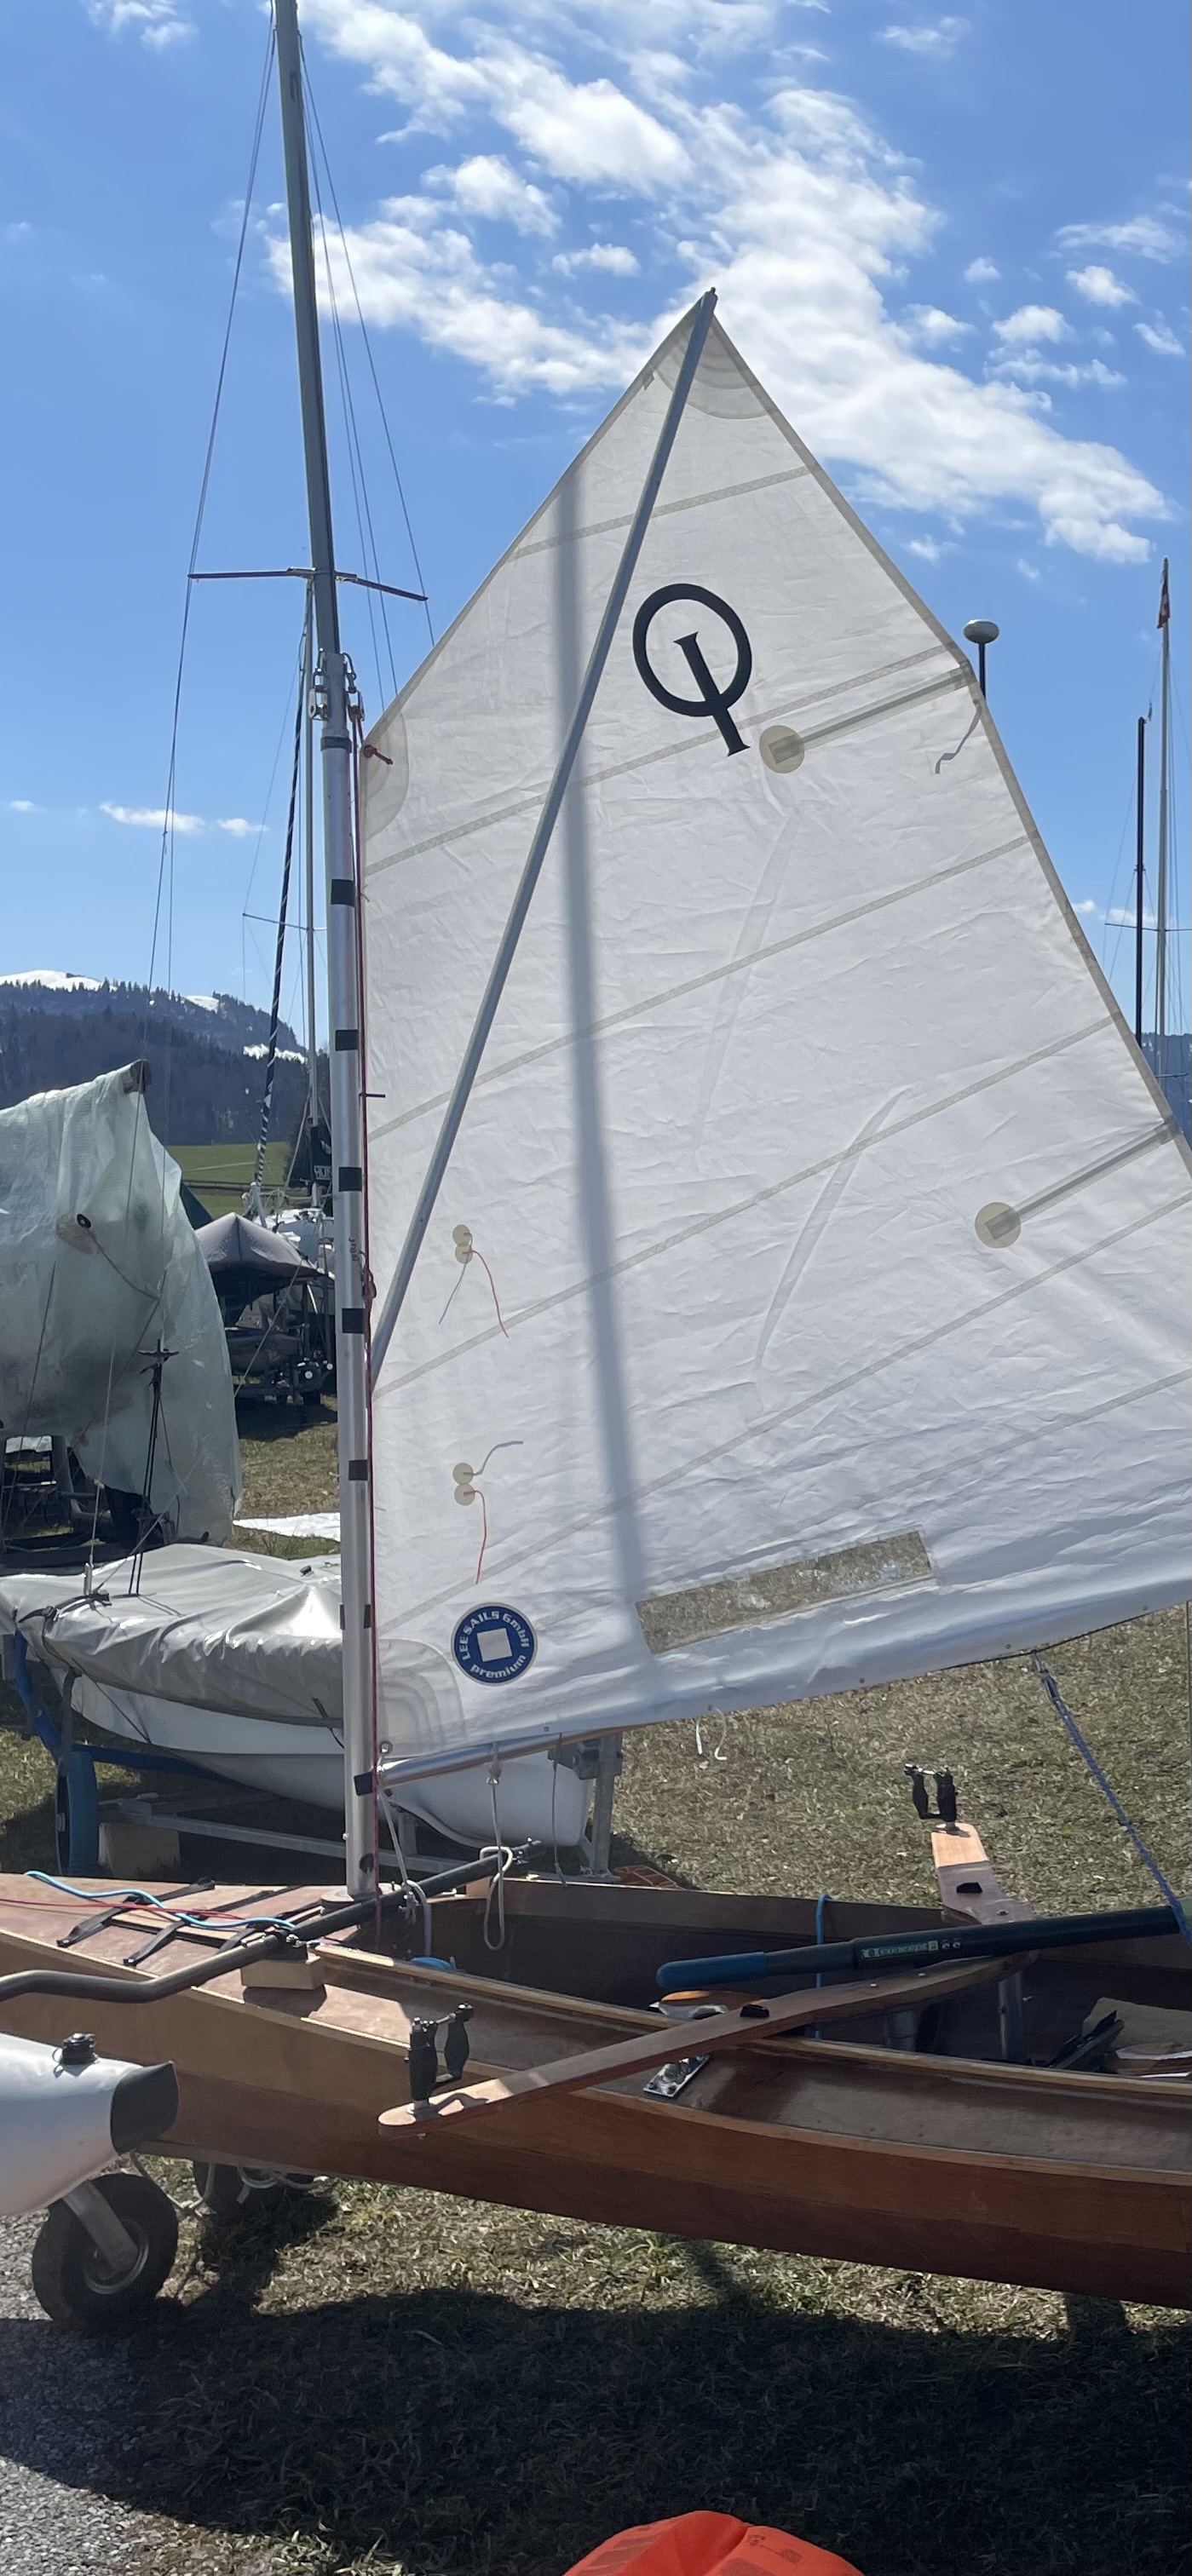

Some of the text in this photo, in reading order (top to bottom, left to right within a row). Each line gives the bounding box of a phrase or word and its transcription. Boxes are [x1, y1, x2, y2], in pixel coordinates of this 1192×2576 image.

[459, 1611, 529, 1660] LEE SAILS GmbH
[470, 1654, 527, 1678] premium
